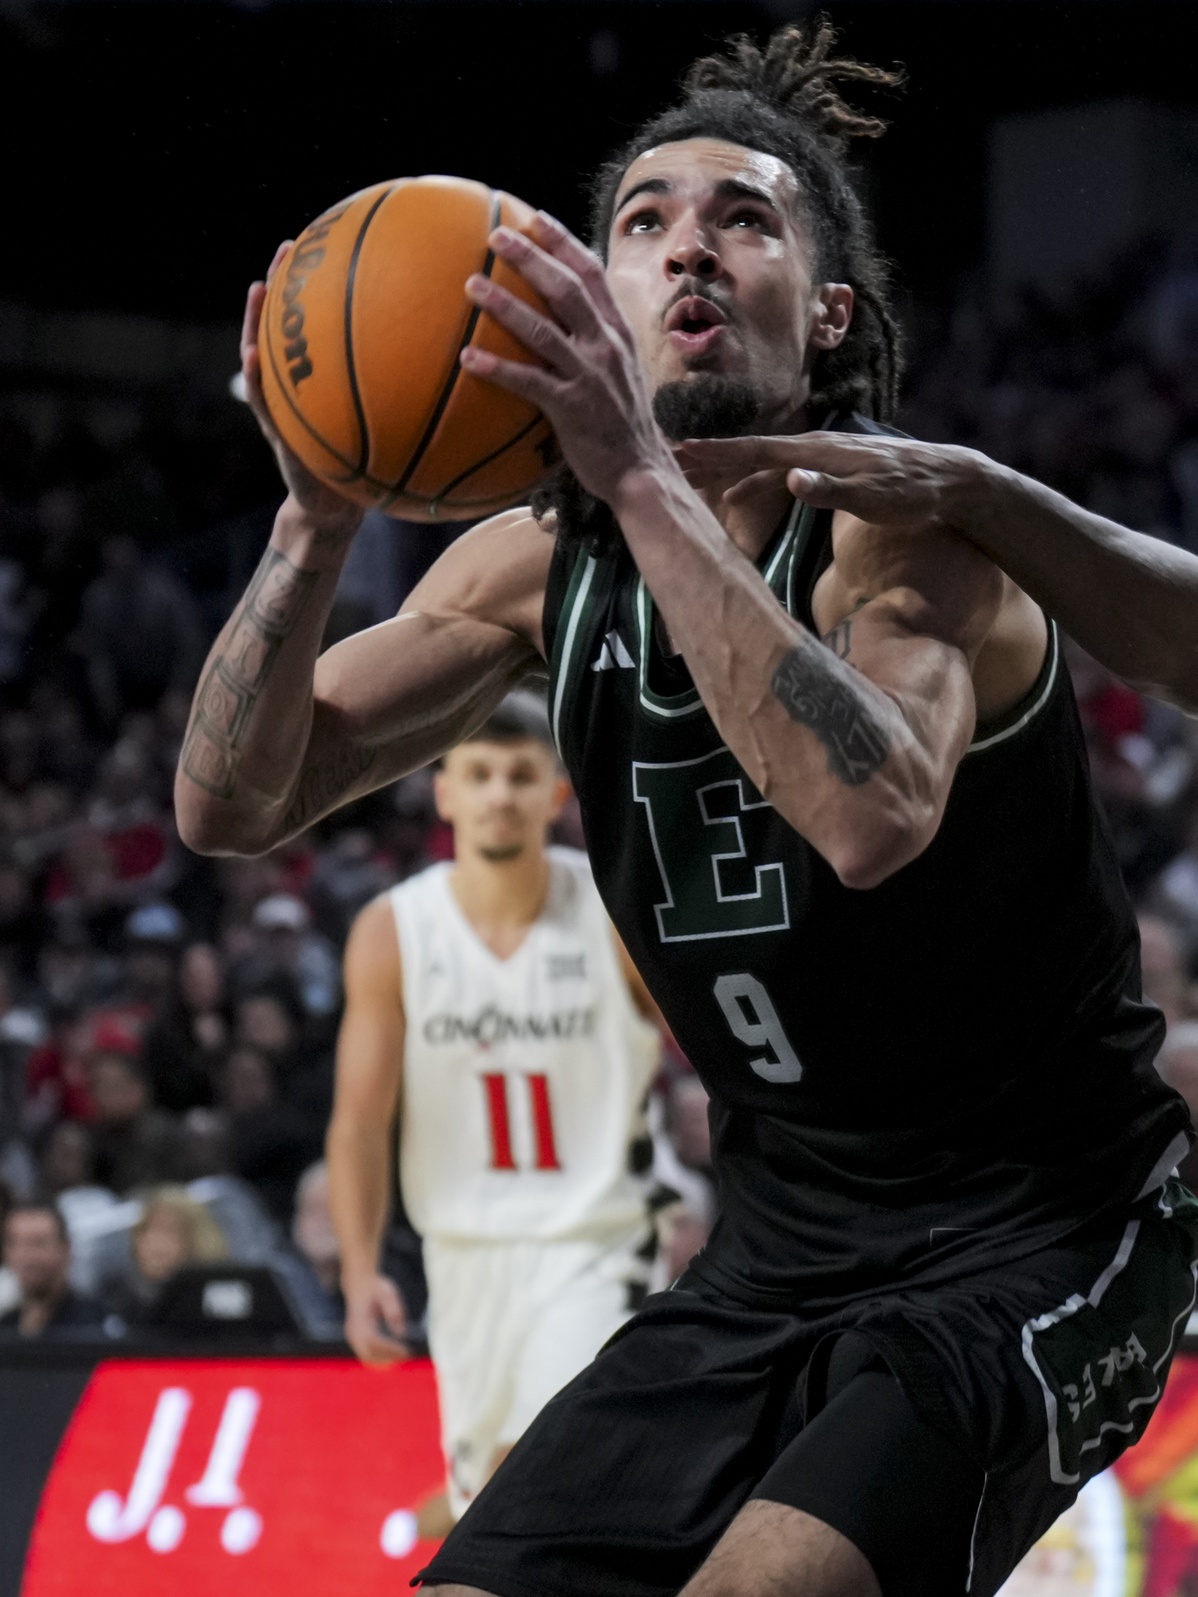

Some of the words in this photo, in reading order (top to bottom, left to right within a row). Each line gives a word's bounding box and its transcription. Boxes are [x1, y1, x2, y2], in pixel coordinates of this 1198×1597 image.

[632, 746, 791, 943] E
[423, 1004, 599, 1046] CINCINNATI
[713, 972, 803, 1084] 9
[481, 1072, 563, 1173] 11
